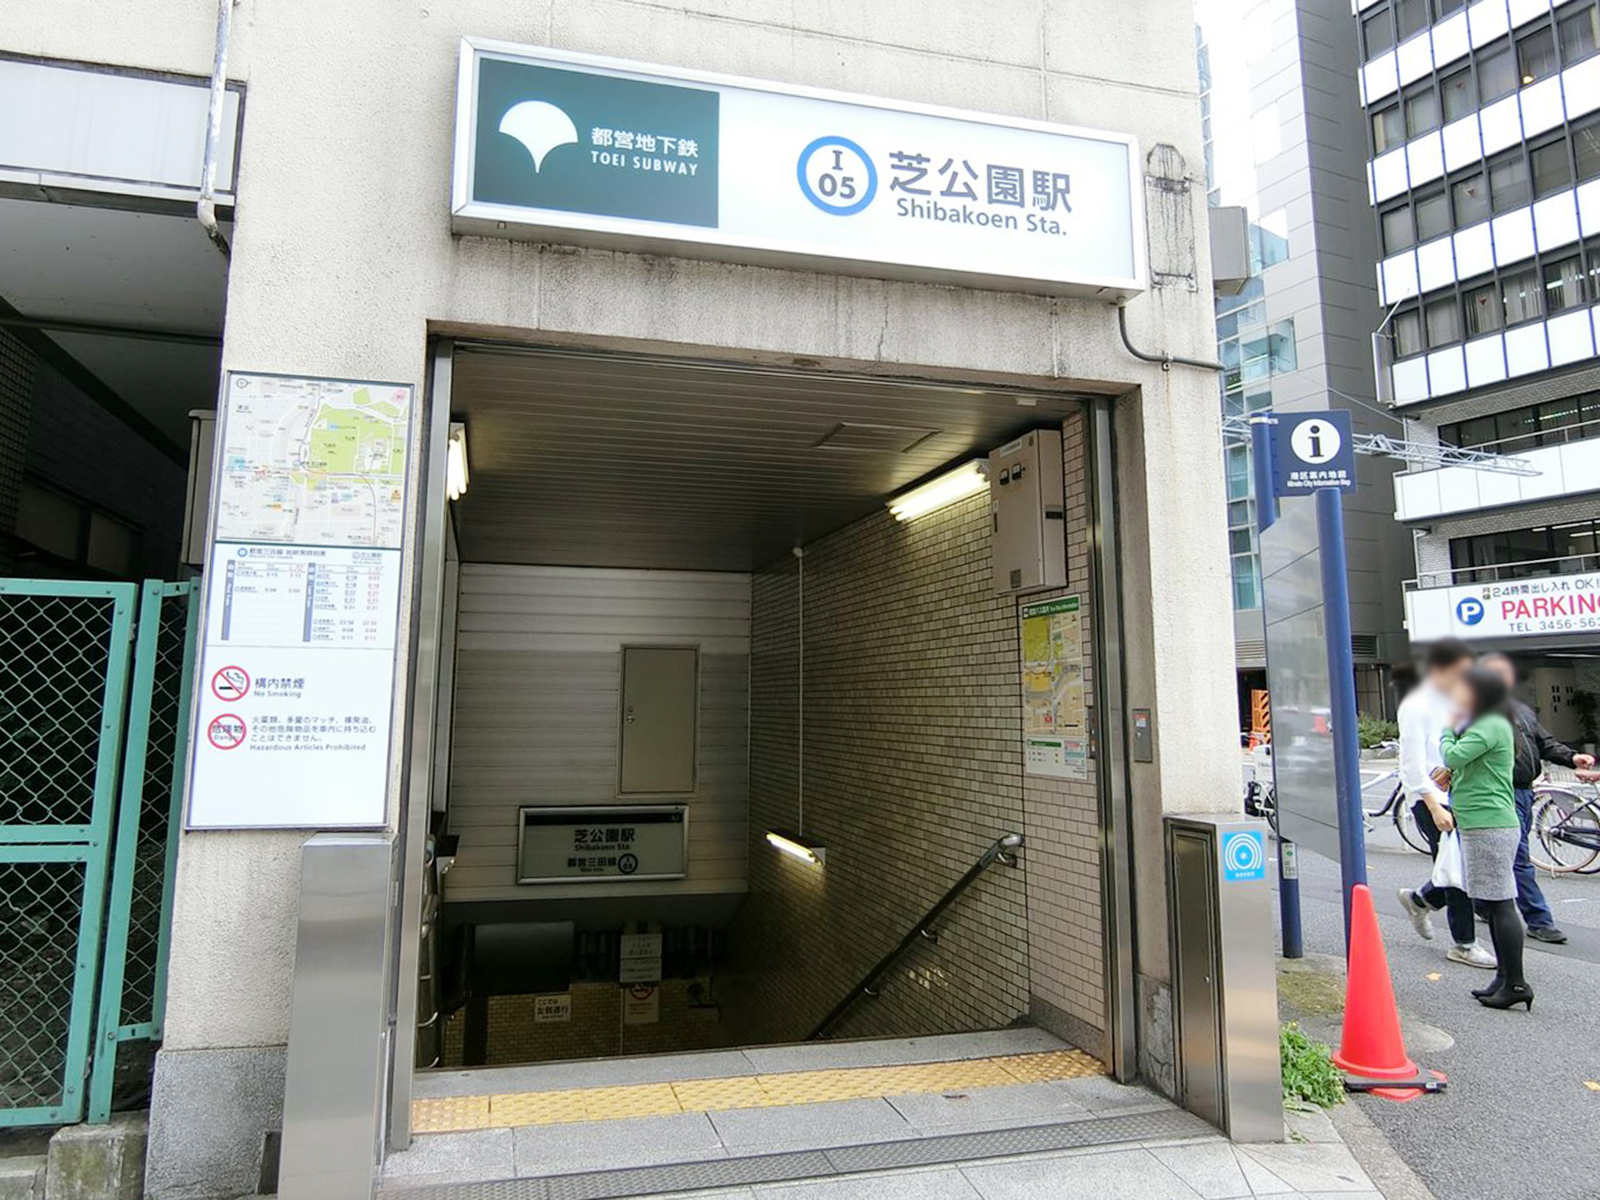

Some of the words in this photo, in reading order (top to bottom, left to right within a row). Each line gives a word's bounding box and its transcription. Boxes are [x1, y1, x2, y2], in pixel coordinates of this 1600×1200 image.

[591, 127, 699, 159] 都営地下鉄
[591, 150, 627, 167] TOEI
[633, 155, 699, 176] SUBWAY
[830, 150, 844, 172] I
[818, 174, 857, 199] 05
[889, 150, 1073, 214] 芝公園駅
[896, 196, 1020, 232] Shibakoen
[1026, 212, 1067, 236] Sta.
[1493, 581, 1571, 598] 24時間出し入れ
[1509, 622, 1532, 632] TEL
[255, 678, 305, 689] 構内禁煙
[254, 690, 266, 698] No
[267, 690, 302, 699] Smoking
[250, 744, 293, 752] Hazardous
[294, 744, 324, 752] Articles
[326, 744, 366, 752] Prohibited
[574, 828, 635, 843] 芝公園駅
[575, 844, 616, 852] Shibakoen
[616, 843, 632, 851] Sta.
